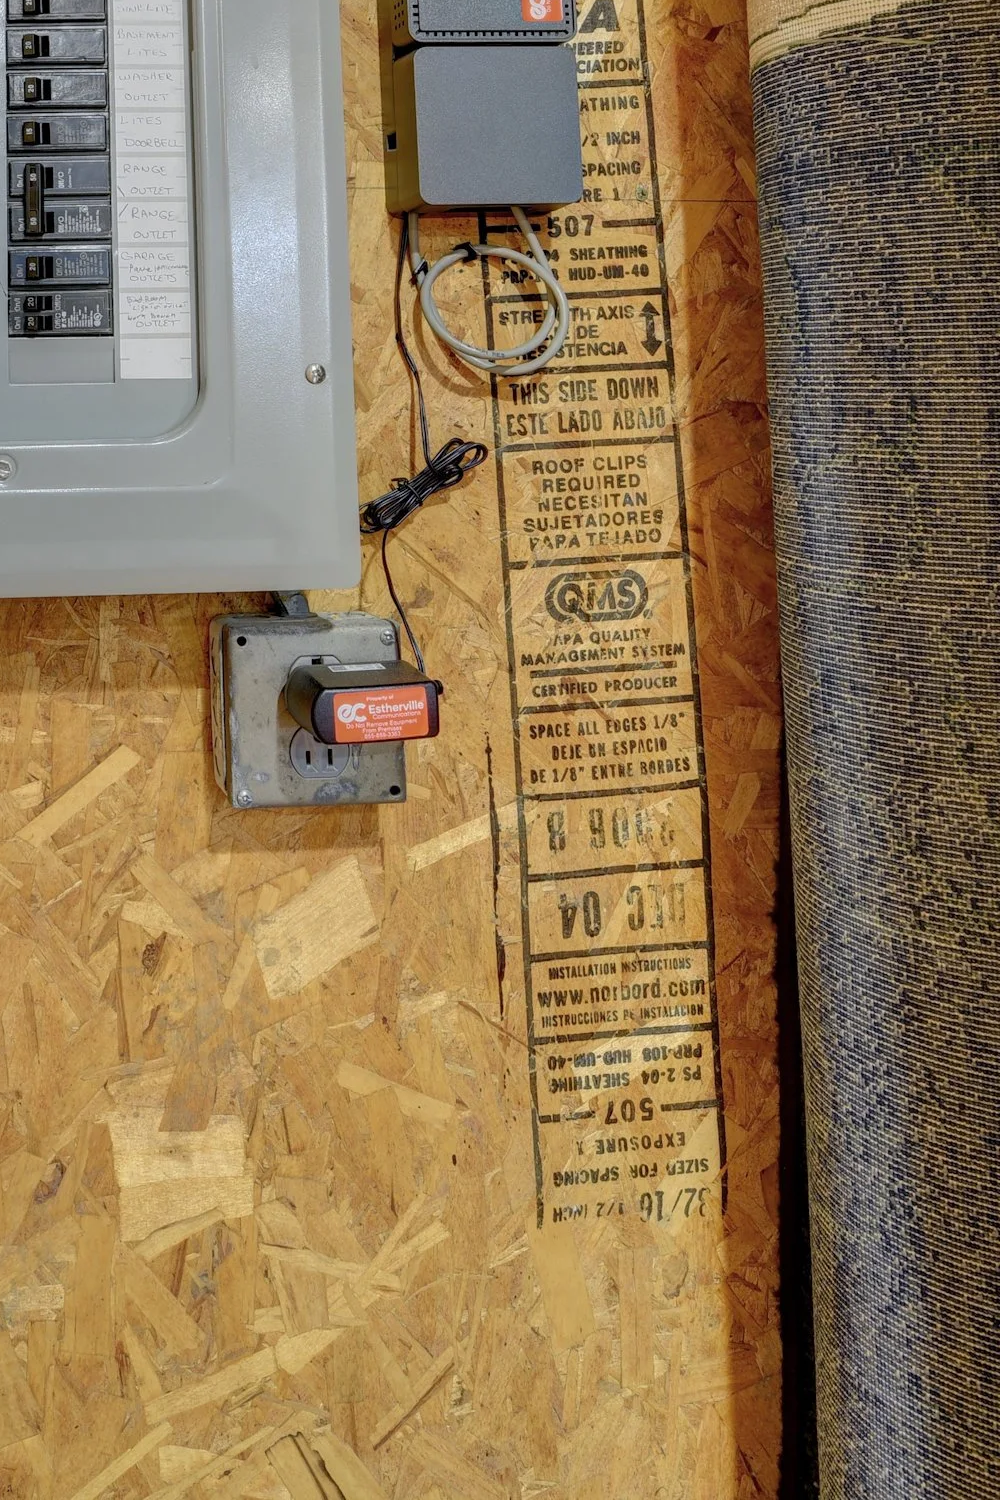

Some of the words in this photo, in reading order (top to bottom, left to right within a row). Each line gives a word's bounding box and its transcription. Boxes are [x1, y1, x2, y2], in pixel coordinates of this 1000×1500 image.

[125, 138, 183, 148] DOORBELL
[123, 164, 167, 175] RANGE
[130, 187, 174, 195] OUTLET
[131, 207, 176, 220] RANGE
[133, 230, 177, 240] OUTLET
[547, 214, 594, 238] 507
[570, 245, 648, 261] SHEATHING
[568, 264, 650, 281] HUD-UM-40
[27, 297, 35, 306] 20
[28, 317, 35, 327] 20
[596, 305, 635, 319] AXIS
[509, 383, 550, 406] THIS
[558, 380, 599, 402] SIDE
[606, 376, 659, 401] DOWN
[506, 412, 549, 437] ESTE
[557, 410, 602, 434] LADO
[612, 406, 666, 431] ABAJO
[532, 458, 585, 475] ROOF
[592, 455, 648, 471] CLIPS
[542, 474, 641, 493] REQUIRED
[538, 492, 648, 512] NECESITAN
[523, 510, 663, 533] SUJETADORES
[551, 574, 642, 618] QMS
[553, 634, 583, 646] APA
[589, 628, 651, 642] QUALITY
[521, 647, 625, 667] MANAGEMENT
[632, 643, 685, 657] SYSTEM
[532, 681, 598, 698] CERTIFIED
[604, 676, 678, 693] PRODUCER
[369, 700, 424, 714] Estherville
[373, 710, 421, 720] Communications
[529, 722, 571, 740] SPACE
[577, 721, 600, 736] ALL
[606, 716, 647, 734] EDGES
[653, 712, 685, 730] 1/8"
[552, 744, 582, 761] DEJE
[612, 737, 668, 756] ESPACIO
[530, 769, 546, 784] DE
[552, 767, 584, 783] 1/8"
[591, 763, 633, 781] ENTRE
[640, 756, 690, 775] BORDES
[558, 891, 601, 939] 04
[549, 962, 616, 980] INSTALLATION
[621, 958, 692, 974] INSTRUCTIONS
[537, 978, 706, 1008] www.norbord.com
[551, 1072, 630, 1093] SHEATHING
[641, 1067, 676, 1085] 2-04
[683, 1065, 701, 1081] PS
[605, 1097, 654, 1125] 507
[595, 1131, 686, 1155] EXPOSURE
[630, 1163, 658, 1179] FOR
[666, 1158, 709, 1175] SIZED
[553, 1166, 619, 1188] SPACING
